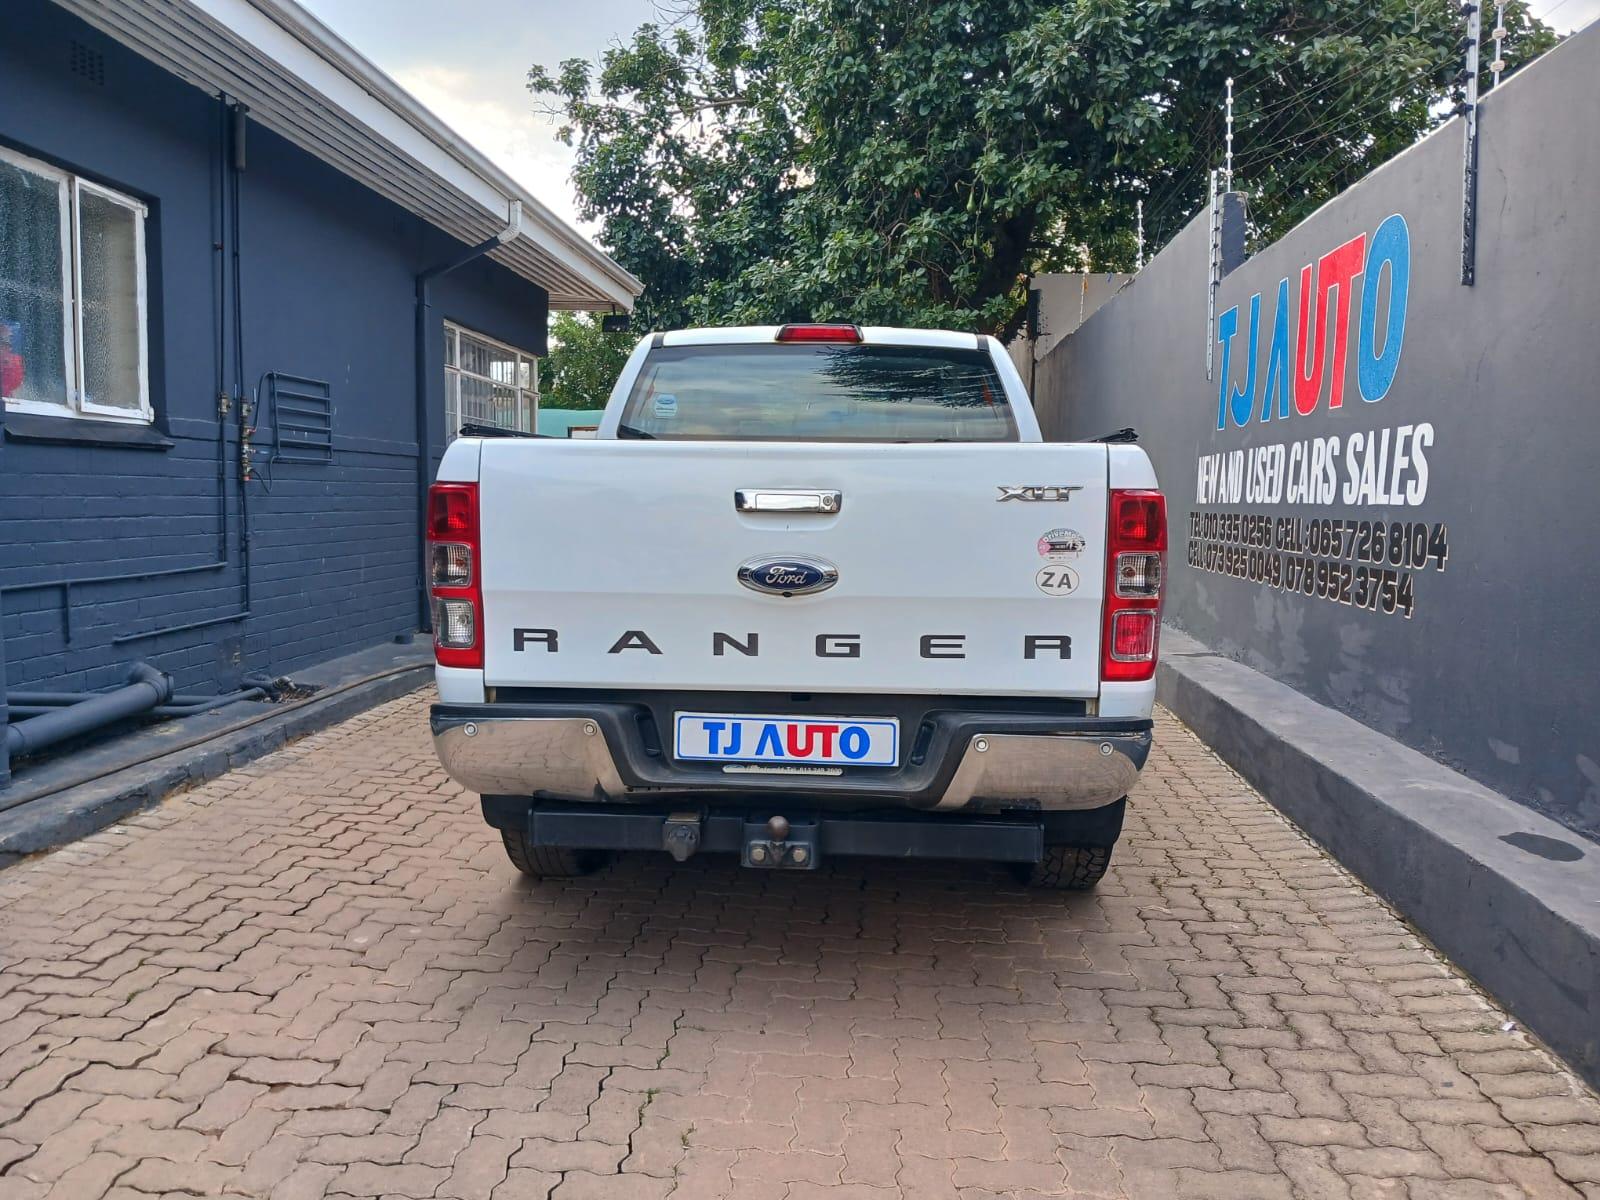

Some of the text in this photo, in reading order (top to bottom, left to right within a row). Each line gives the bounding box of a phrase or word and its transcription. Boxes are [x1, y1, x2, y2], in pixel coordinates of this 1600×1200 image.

[1217, 213, 1410, 431] TJ AUTO
[1196, 423, 1434, 505] NEW AND USED CARS SALES
[996, 485, 1084, 502] XLT
[1345, 520, 1387, 565] 726
[1388, 522, 1449, 572] 8104
[766, 566, 808, 584] Ford
[1041, 571, 1072, 589] ZA
[1354, 566, 1414, 619] 3754
[513, 627, 1072, 661] RANGER
[703, 721, 871, 760] TJ AUTO
